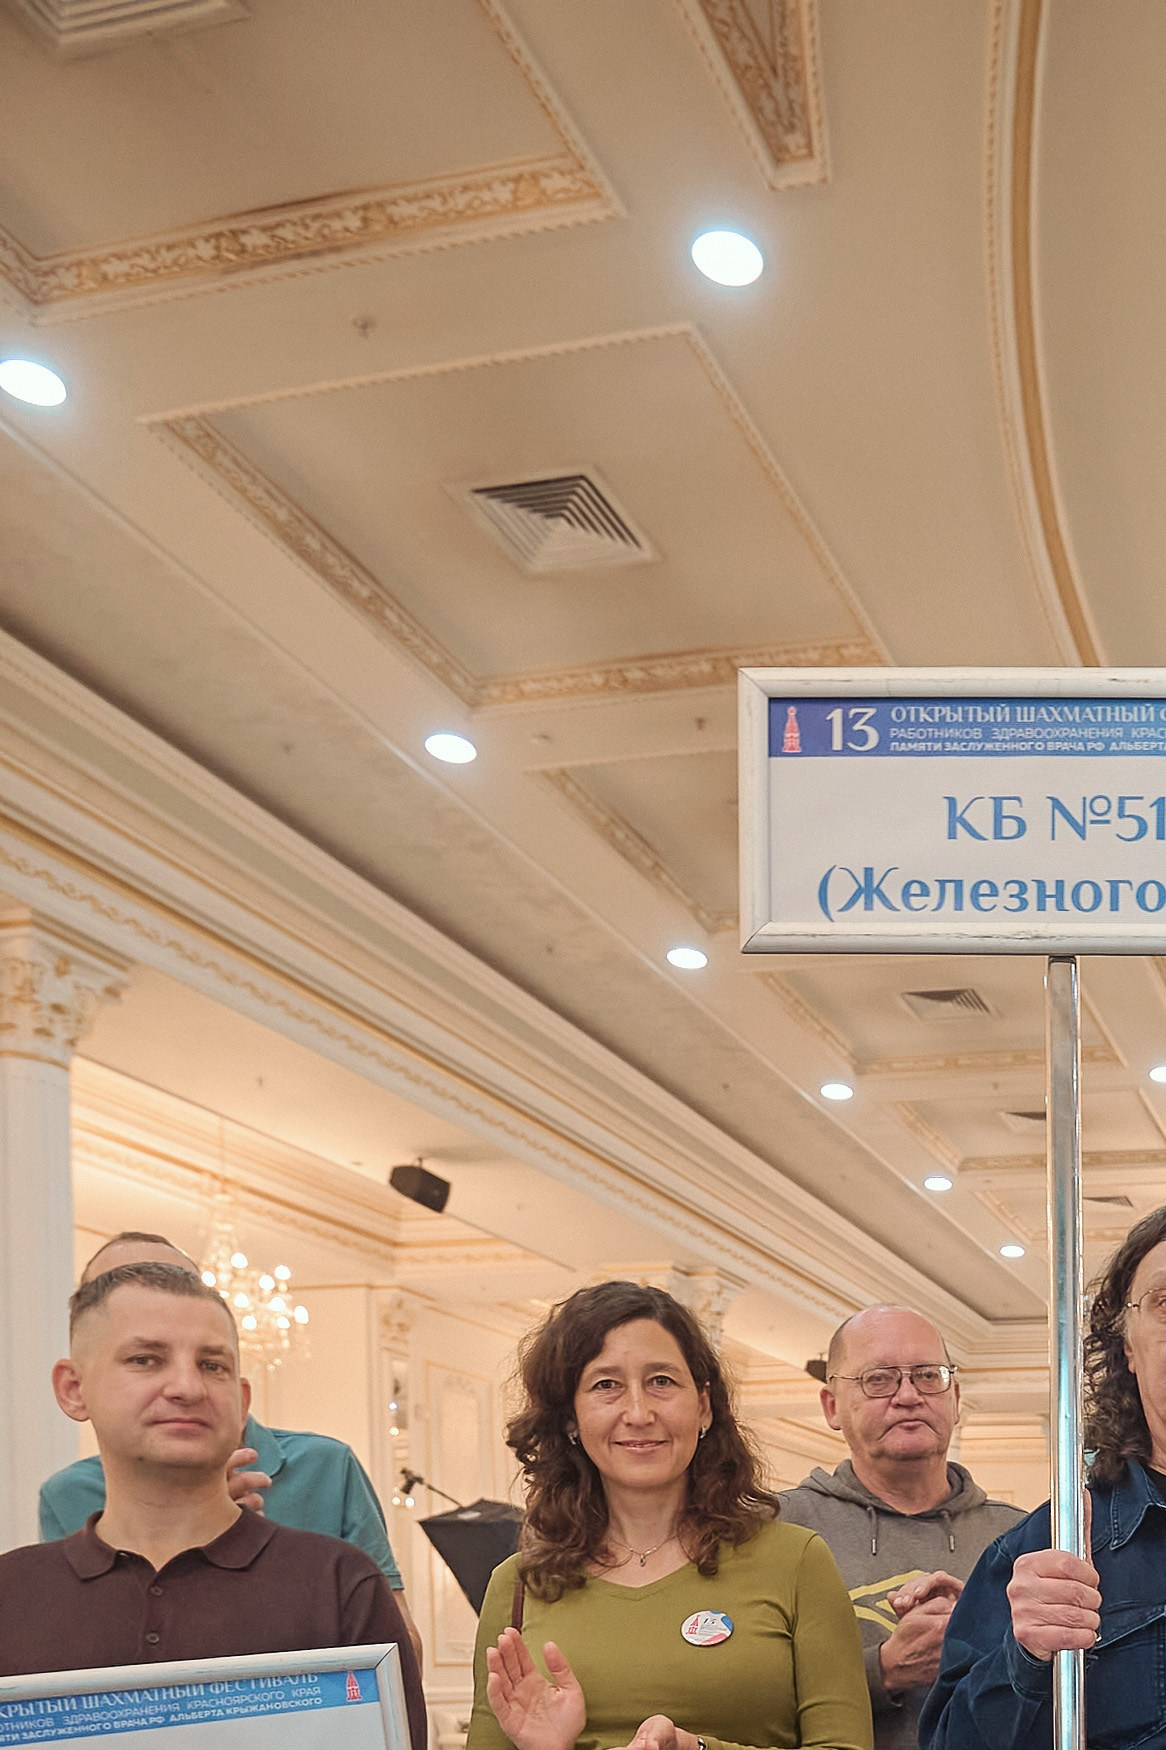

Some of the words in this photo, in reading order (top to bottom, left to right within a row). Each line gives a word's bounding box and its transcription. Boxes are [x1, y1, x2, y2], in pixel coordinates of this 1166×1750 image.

[825, 707, 880, 752] 13
[890, 704, 1011, 723] ОТКРЫТЫЙ
[1017, 704, 1154, 723] ШАХМАТНЫЙ
[890, 728, 982, 739] РАБОТНИКОВ
[991, 727, 1123, 739] ЗДРАВООХРАНЕНИЯ
[890, 742, 942, 752] ПАМЯТИ
[944, 742, 1046, 752] ЗАСЛУЖЕННОГО
[1047, 742, 1086, 752] ВРАЧА
[1087, 742, 1105, 752] РФ
[942, 796, 1028, 841] КБ
[1046, 795, 1166, 842] №51
[22, 1722, 112, 1740] ЗАСЛУЖЕННОГО
[113, 1718, 148, 1729] ВРАЧА
[149, 1716, 165, 1725] РФ
[170, 1709, 224, 1722] АЛЬБЕРТА
[226, 1697, 323, 1716] КРЫЖАНОВСКОГО
[63, 1703, 180, 1725] ЗДРАВООХРАНЕНИЯ
[187, 1690, 285, 1710] КРАСНОЯРСКОГО
[292, 1686, 321, 1698] КРАЯ
